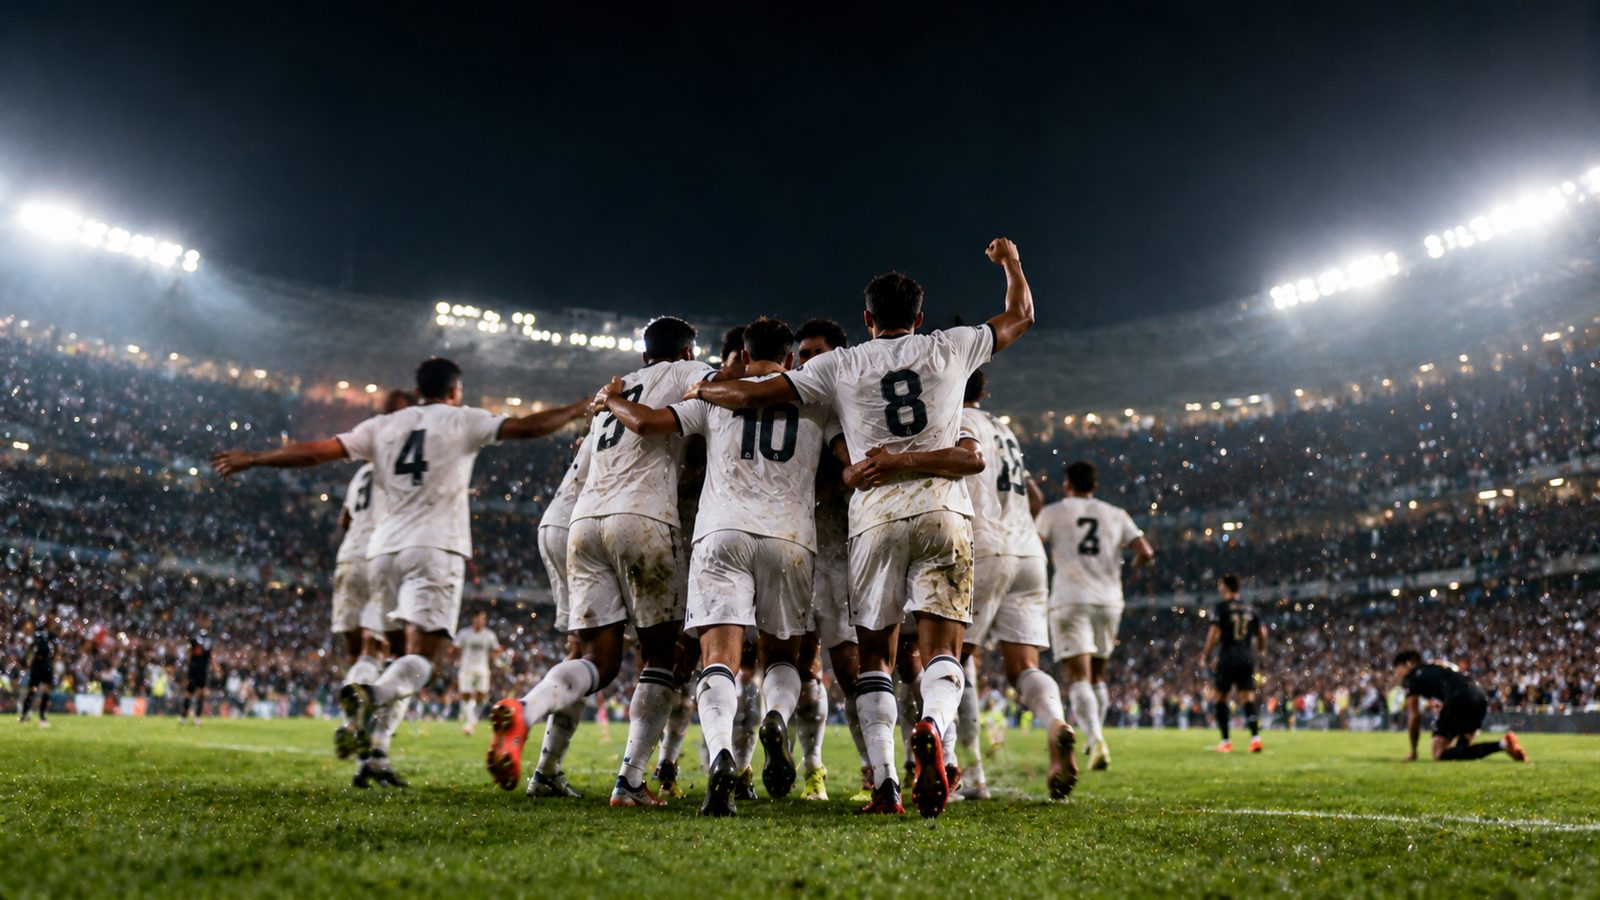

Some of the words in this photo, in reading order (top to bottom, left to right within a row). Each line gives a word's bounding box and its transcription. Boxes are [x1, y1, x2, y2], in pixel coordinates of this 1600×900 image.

[732, 402, 799, 464] 10
[880, 368, 928, 438] 8
[394, 428, 429, 486] 4
